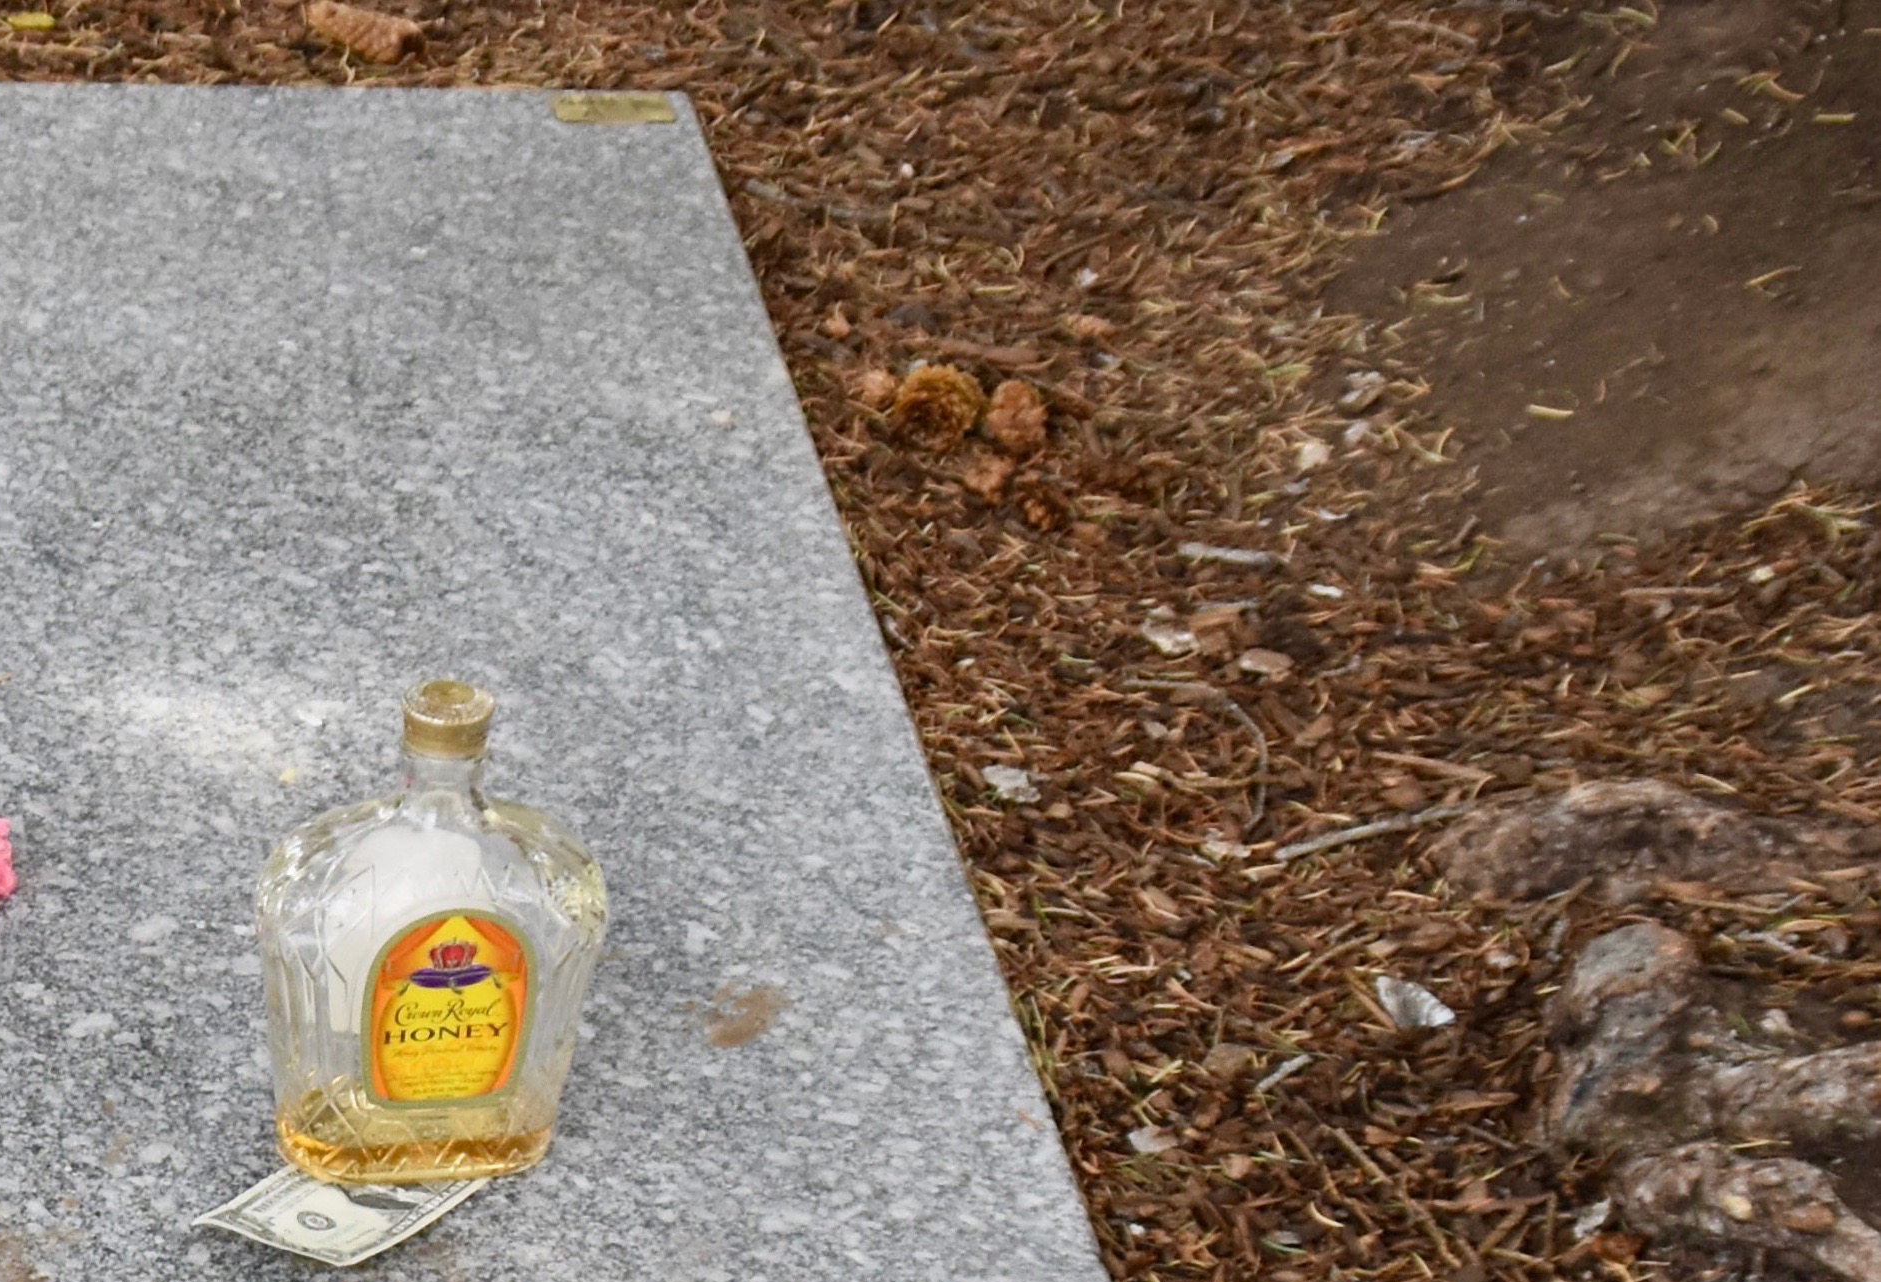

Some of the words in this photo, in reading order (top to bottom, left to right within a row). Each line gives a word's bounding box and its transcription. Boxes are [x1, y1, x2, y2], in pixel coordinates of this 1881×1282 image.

[394, 1001, 442, 1027] Crown
[431, 998, 501, 1023] Royal
[383, 1022, 508, 1045] HONEY
